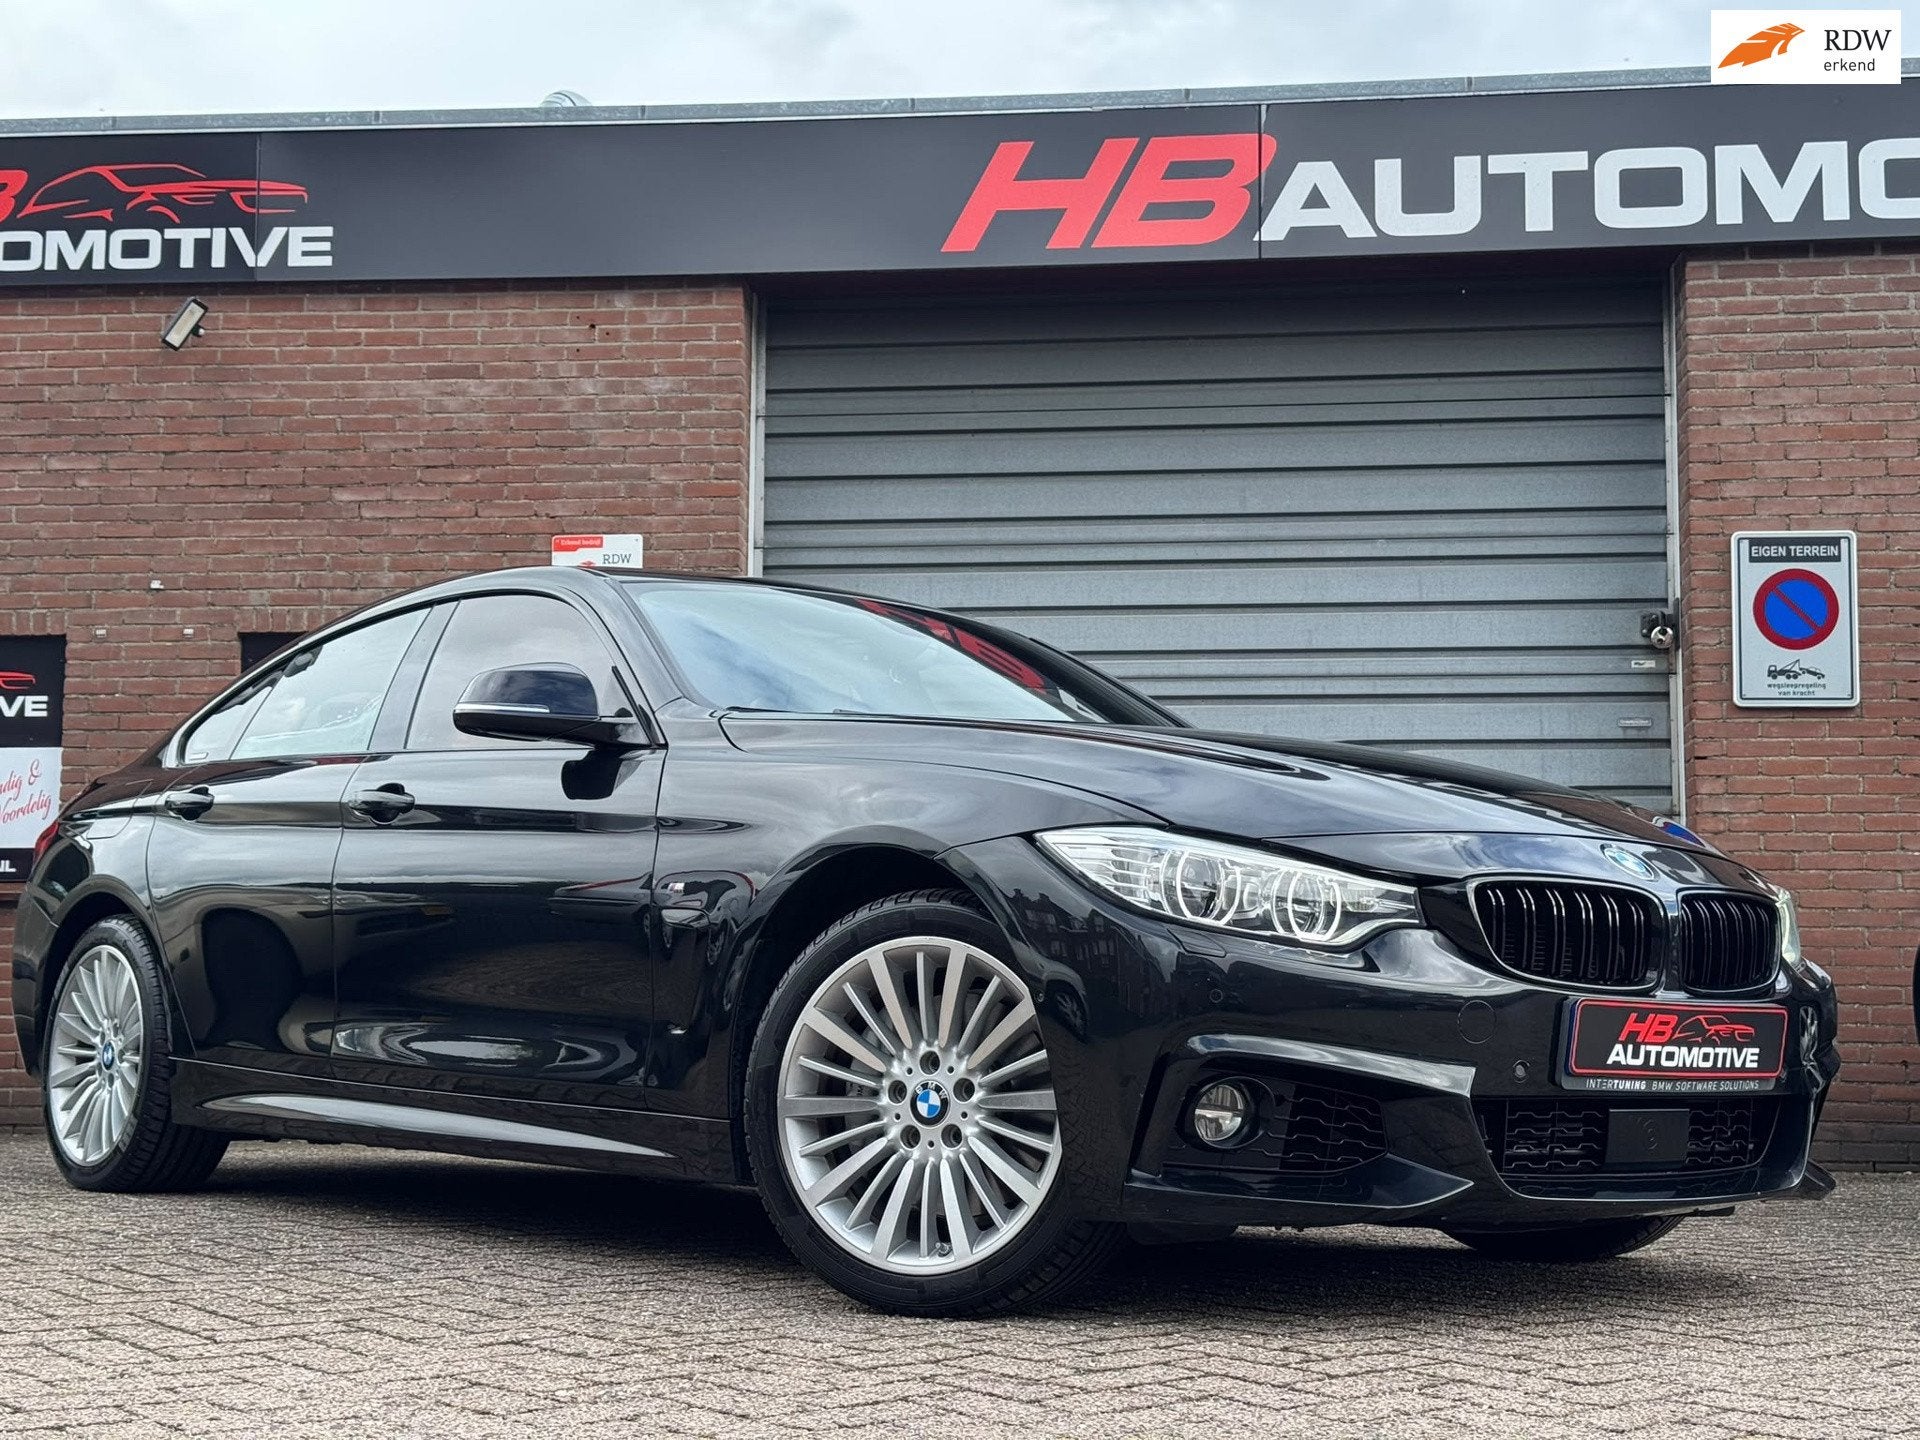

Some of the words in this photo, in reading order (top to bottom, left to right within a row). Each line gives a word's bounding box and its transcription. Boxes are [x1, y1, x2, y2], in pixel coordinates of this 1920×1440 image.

[941, 133, 1277, 252] HB
[602, 553, 632, 564] RDW
[1751, 545, 1786, 557] EIGEN
[1788, 545, 1839, 557] TERREIN
[1618, 1012, 1678, 1043] HB
[1606, 1043, 1760, 1068] AUTOMOTIVE
[1586, 1078, 1646, 1090] INTERTUNING
[1652, 1081, 1673, 1091] BMW
[1675, 1081, 1717, 1091] SOFTWARE
[1719, 1080, 1760, 1091] SOLUTIONS
